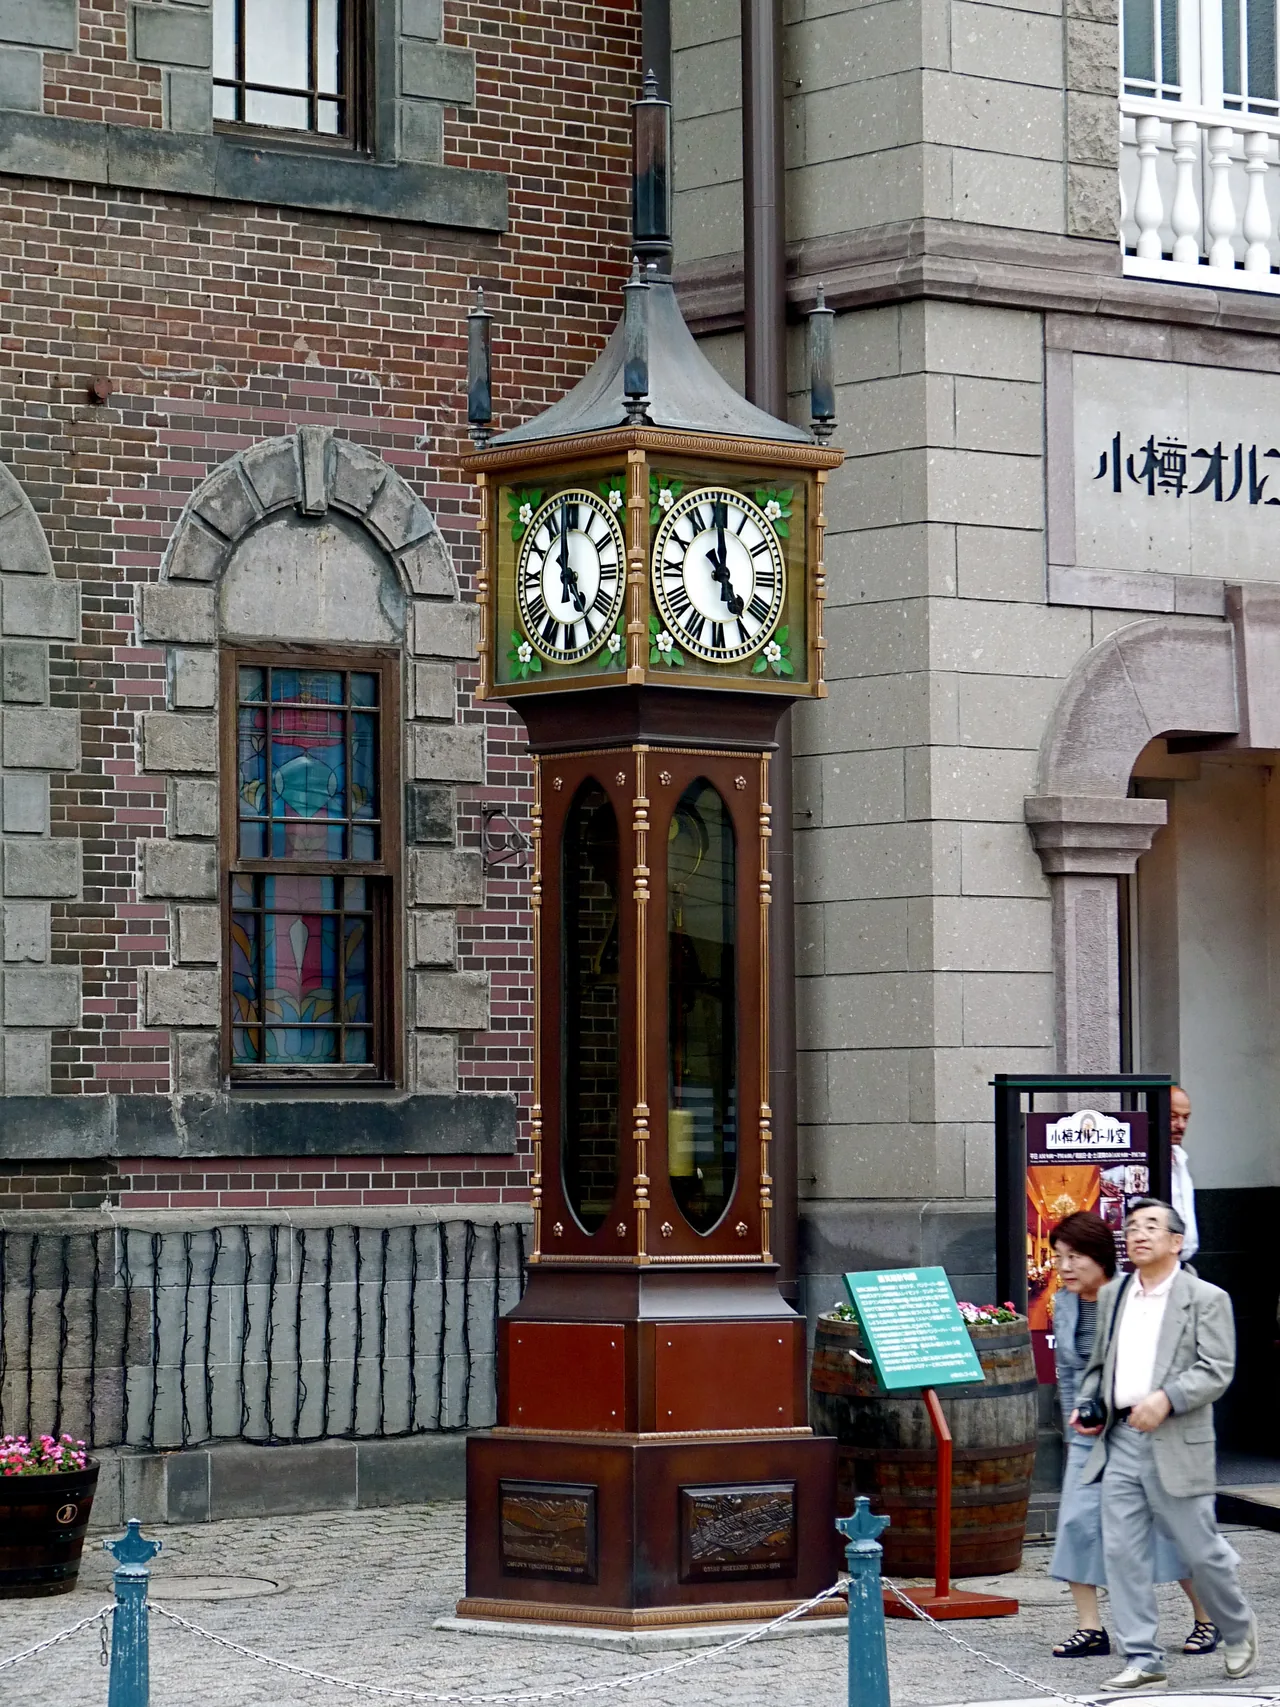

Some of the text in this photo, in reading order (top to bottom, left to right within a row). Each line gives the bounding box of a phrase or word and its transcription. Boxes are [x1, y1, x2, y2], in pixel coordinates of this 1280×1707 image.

[750, 539, 770, 558] II
[601, 563, 617, 580] III
[756, 571, 775, 588] III
[1050, 1128, 1126, 1144] 小樽オルゴール堂
